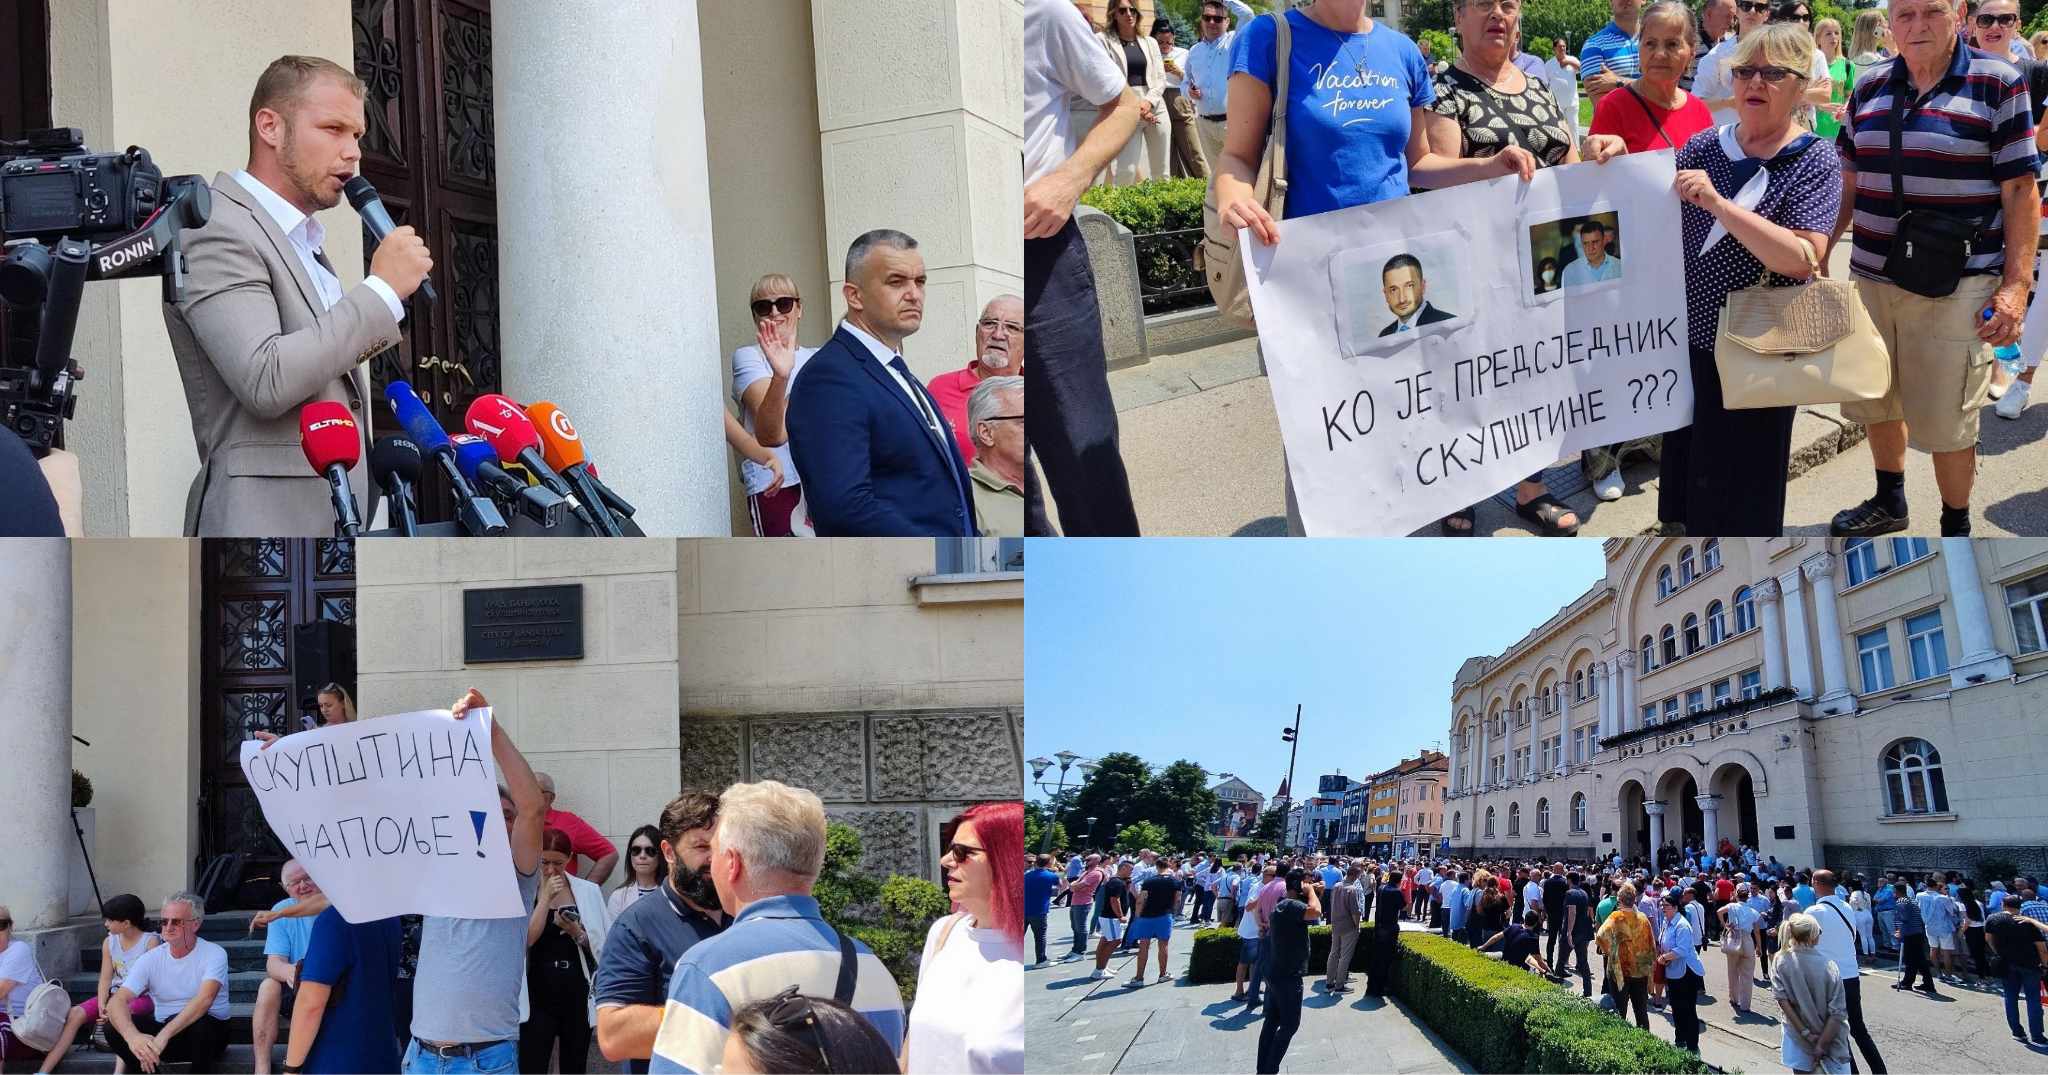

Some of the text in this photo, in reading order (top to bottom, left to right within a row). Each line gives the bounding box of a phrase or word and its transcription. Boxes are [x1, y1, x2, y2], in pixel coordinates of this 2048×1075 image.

[1308, 61, 1399, 89] Vacation
[1322, 90, 1393, 117] forever
[100, 238, 154, 272] RONIN
[1322, 317, 1678, 451] КО ЈЕ ПРЕДСЈЕДНИК
[1416, 369, 1678, 486] СКУПШТИНЕ ???
[250, 728, 487, 791] СКУПШТИНА
